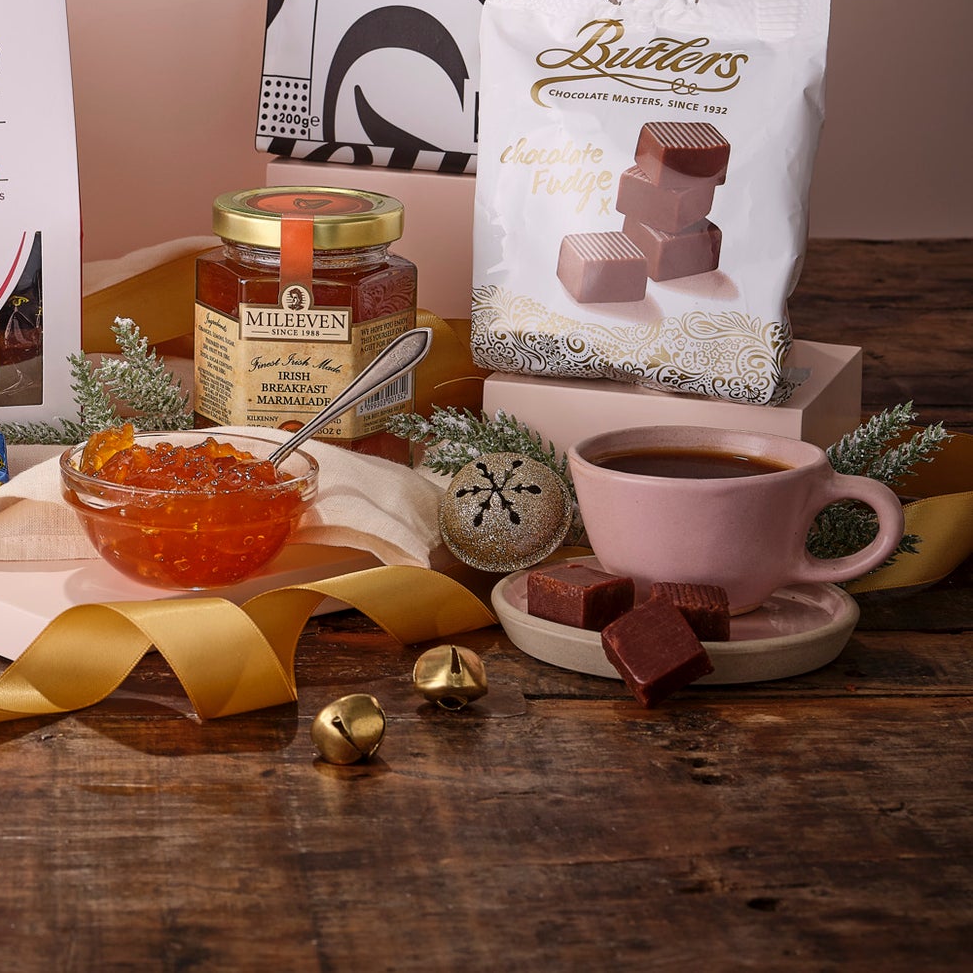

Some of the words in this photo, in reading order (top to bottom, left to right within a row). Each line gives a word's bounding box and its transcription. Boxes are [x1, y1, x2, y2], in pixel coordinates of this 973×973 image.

[534, 18, 749, 91] Butlers
[548, 88, 609, 101] CHOCOLATE
[612, 93, 664, 107] MASTERS,
[668, 99, 699, 111] SINCE
[703, 104, 728, 115] 1932
[500, 137, 604, 165] chocolate
[531, 168, 613, 215] Fudge
[246, 310, 346, 329] MILEEVEN
[271, 328, 299, 336] SINCE
[302, 329, 320, 337] 1988
[248, 355, 281, 373] Finest
[281, 352, 312, 367] Irish
[312, 358, 343, 374] Made
[278, 371, 311, 381] IRISH
[261, 383, 328, 394] BREAKFAST
[256, 395, 332, 407] MARMALADE
